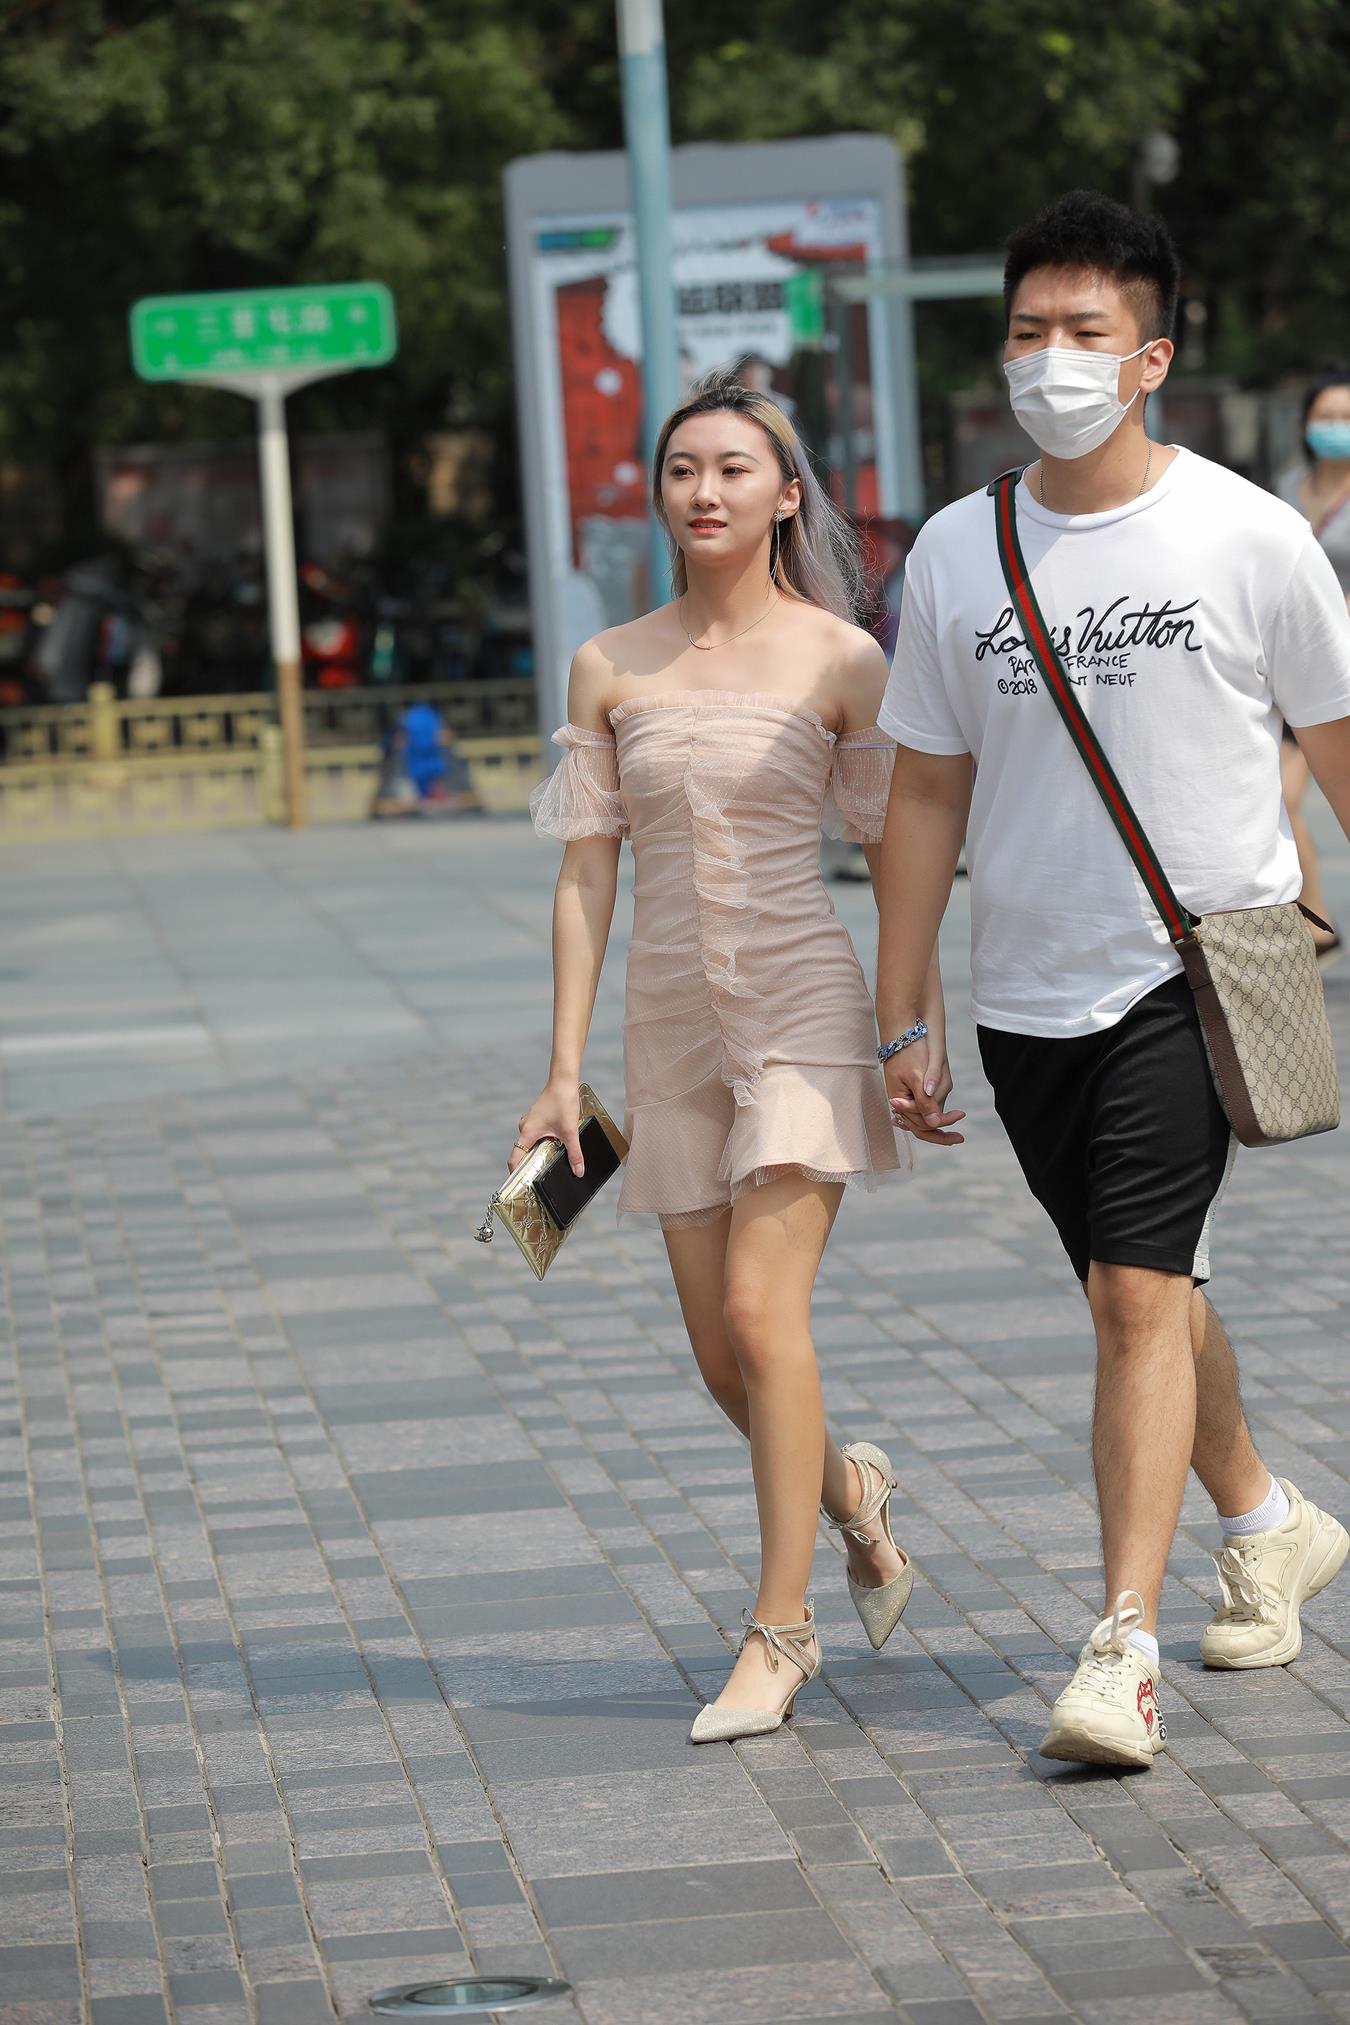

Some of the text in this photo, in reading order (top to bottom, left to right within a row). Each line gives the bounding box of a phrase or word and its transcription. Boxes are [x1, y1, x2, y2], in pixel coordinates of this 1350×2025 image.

[975, 595, 1203, 661] Lois Vuitton
[1064, 652, 1131, 670] FRANCE
[1096, 672, 1137, 687] NEUF
